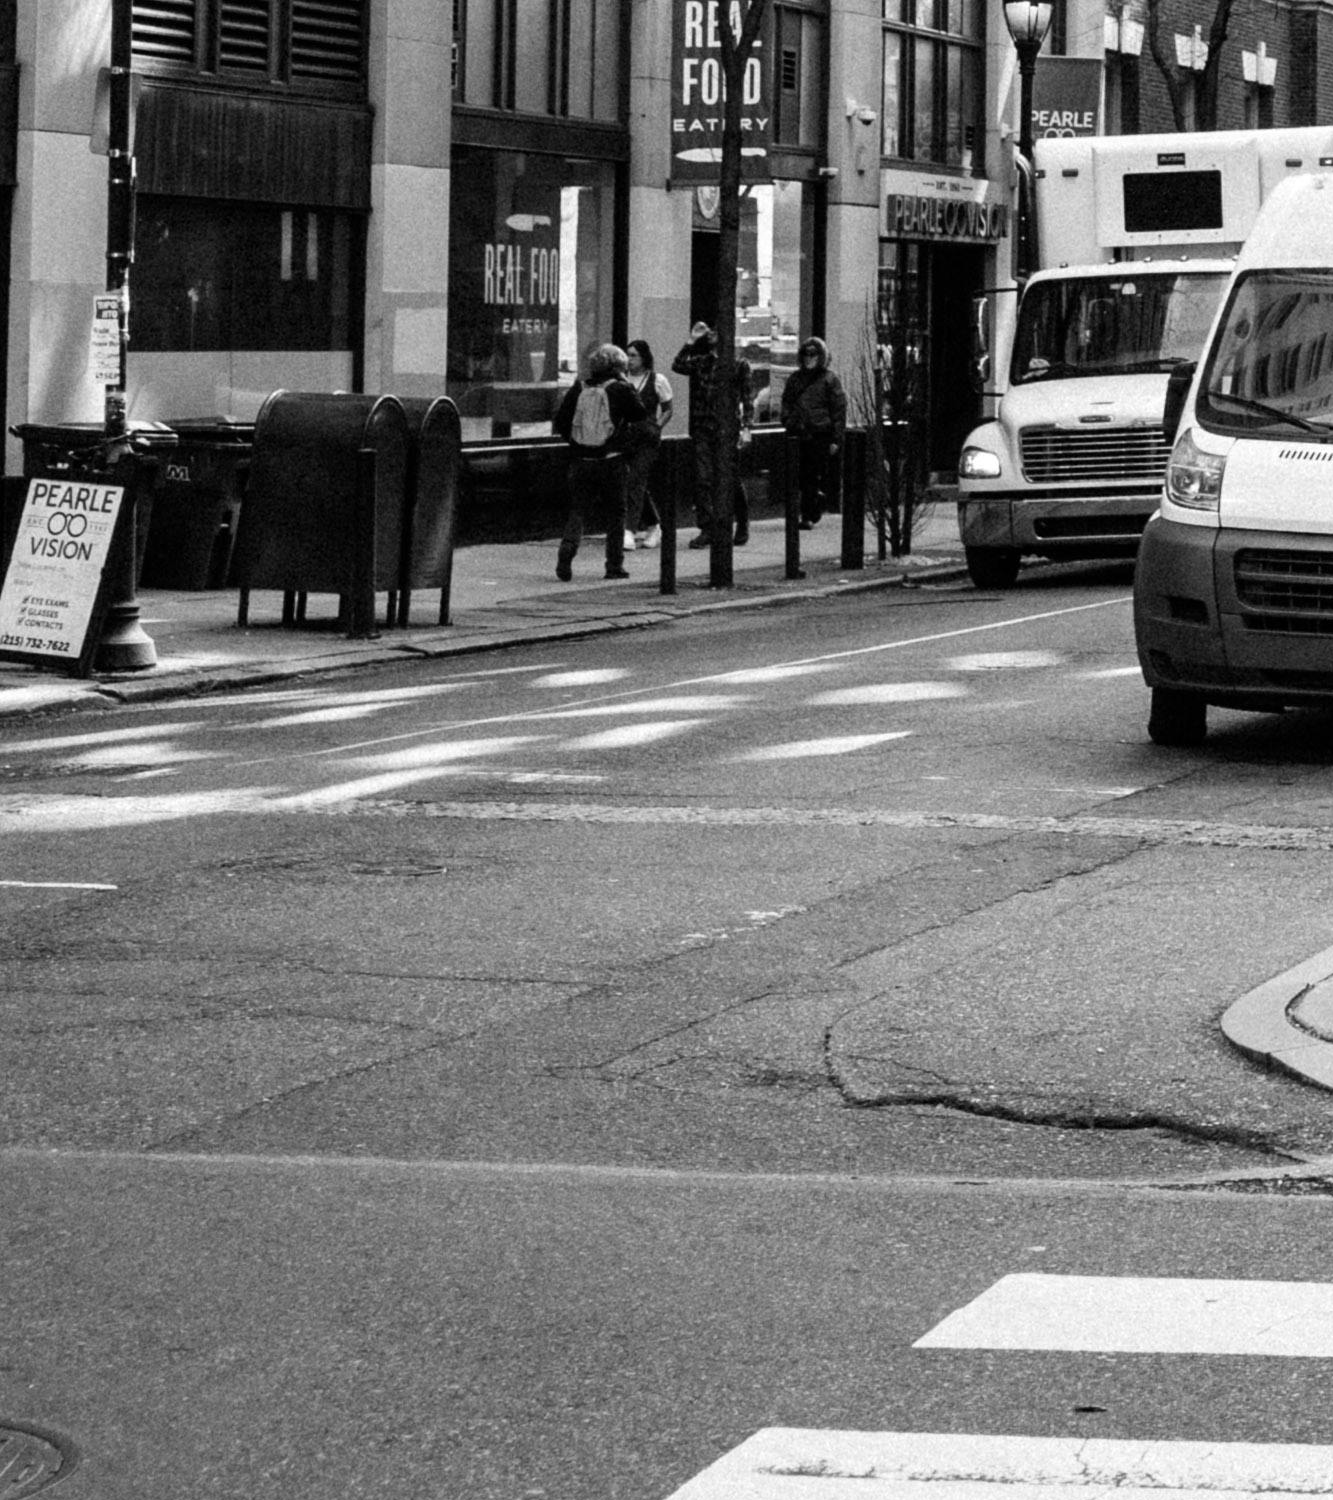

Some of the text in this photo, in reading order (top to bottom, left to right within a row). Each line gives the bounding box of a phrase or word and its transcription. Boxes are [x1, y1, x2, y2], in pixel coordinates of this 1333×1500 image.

[683, 58, 761, 105] FOD
[673, 118, 769, 132] EATRY
[1031, 110, 1094, 128] PEARLE
[896, 195, 1009, 238] PEARLE VISION
[484, 244, 523, 305] REAL
[502, 318, 549, 334] EATERY
[31, 482, 117, 514] PEARLE
[30, 537, 93, 561] VISION
